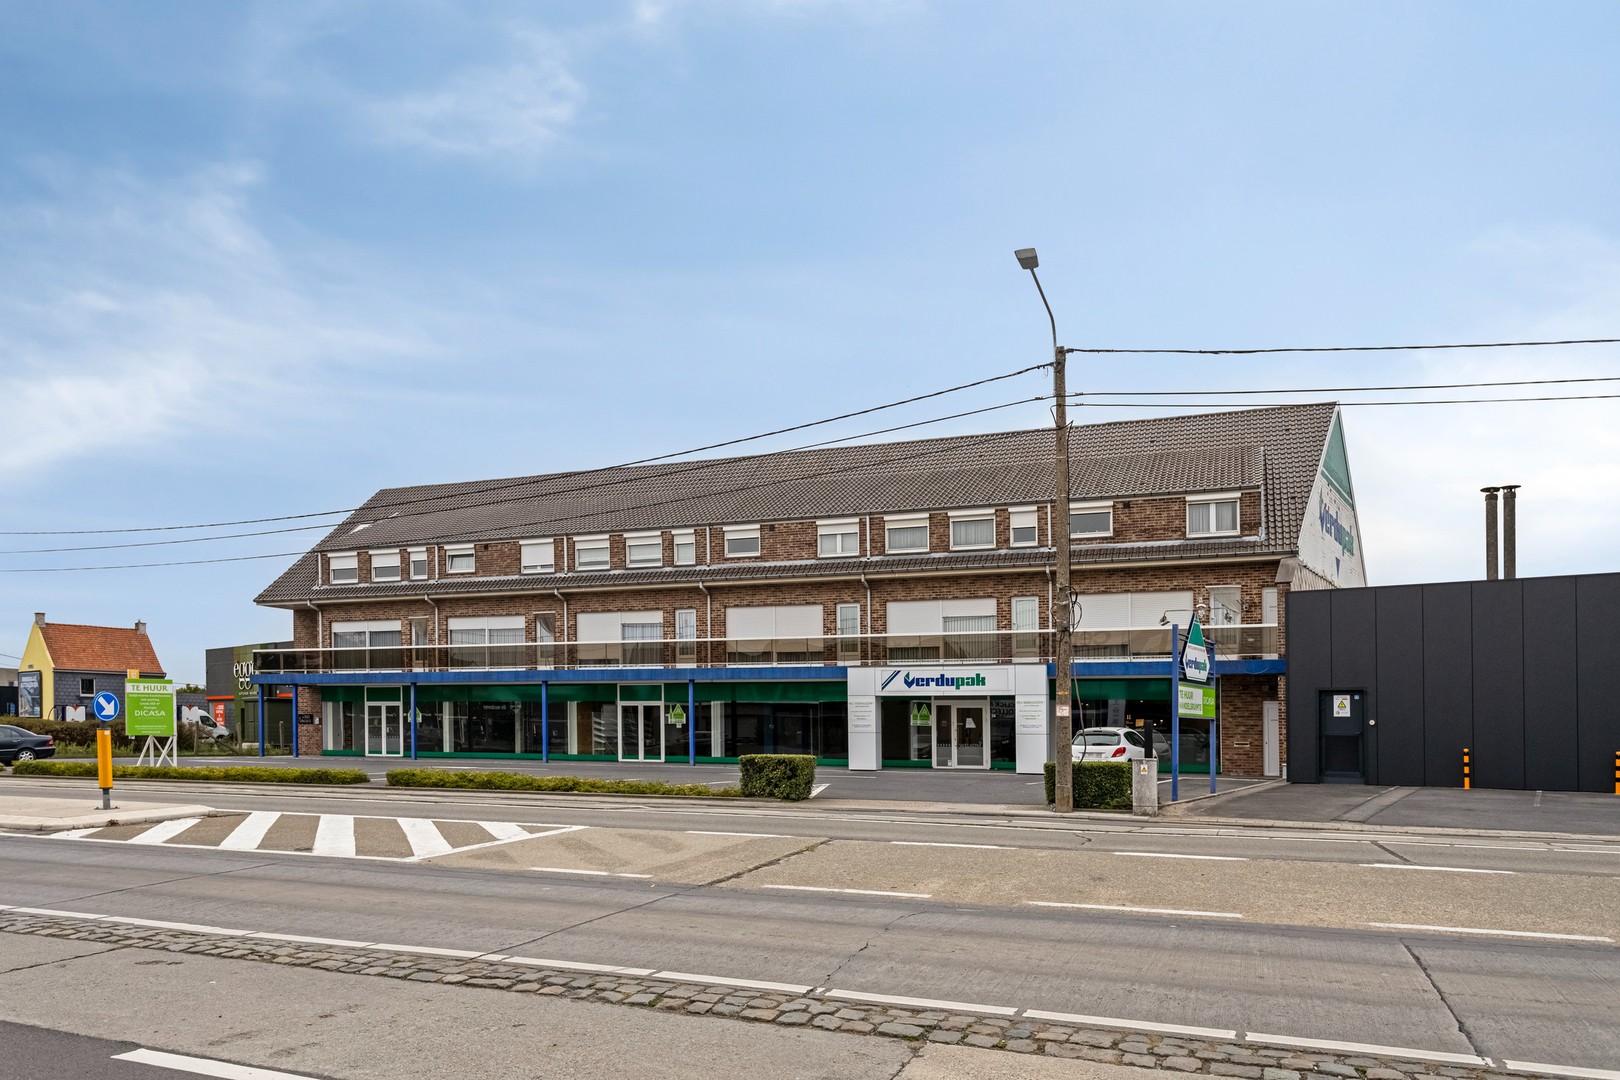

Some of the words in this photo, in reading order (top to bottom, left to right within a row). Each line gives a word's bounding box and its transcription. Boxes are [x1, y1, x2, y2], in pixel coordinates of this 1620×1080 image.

[903, 671, 986, 690] Verdupak
[131, 684, 141, 692] TE
[143, 684, 169, 692] HUUR
[1184, 690, 1193, 700] HUUR
[134, 709, 166, 717] DICASA
